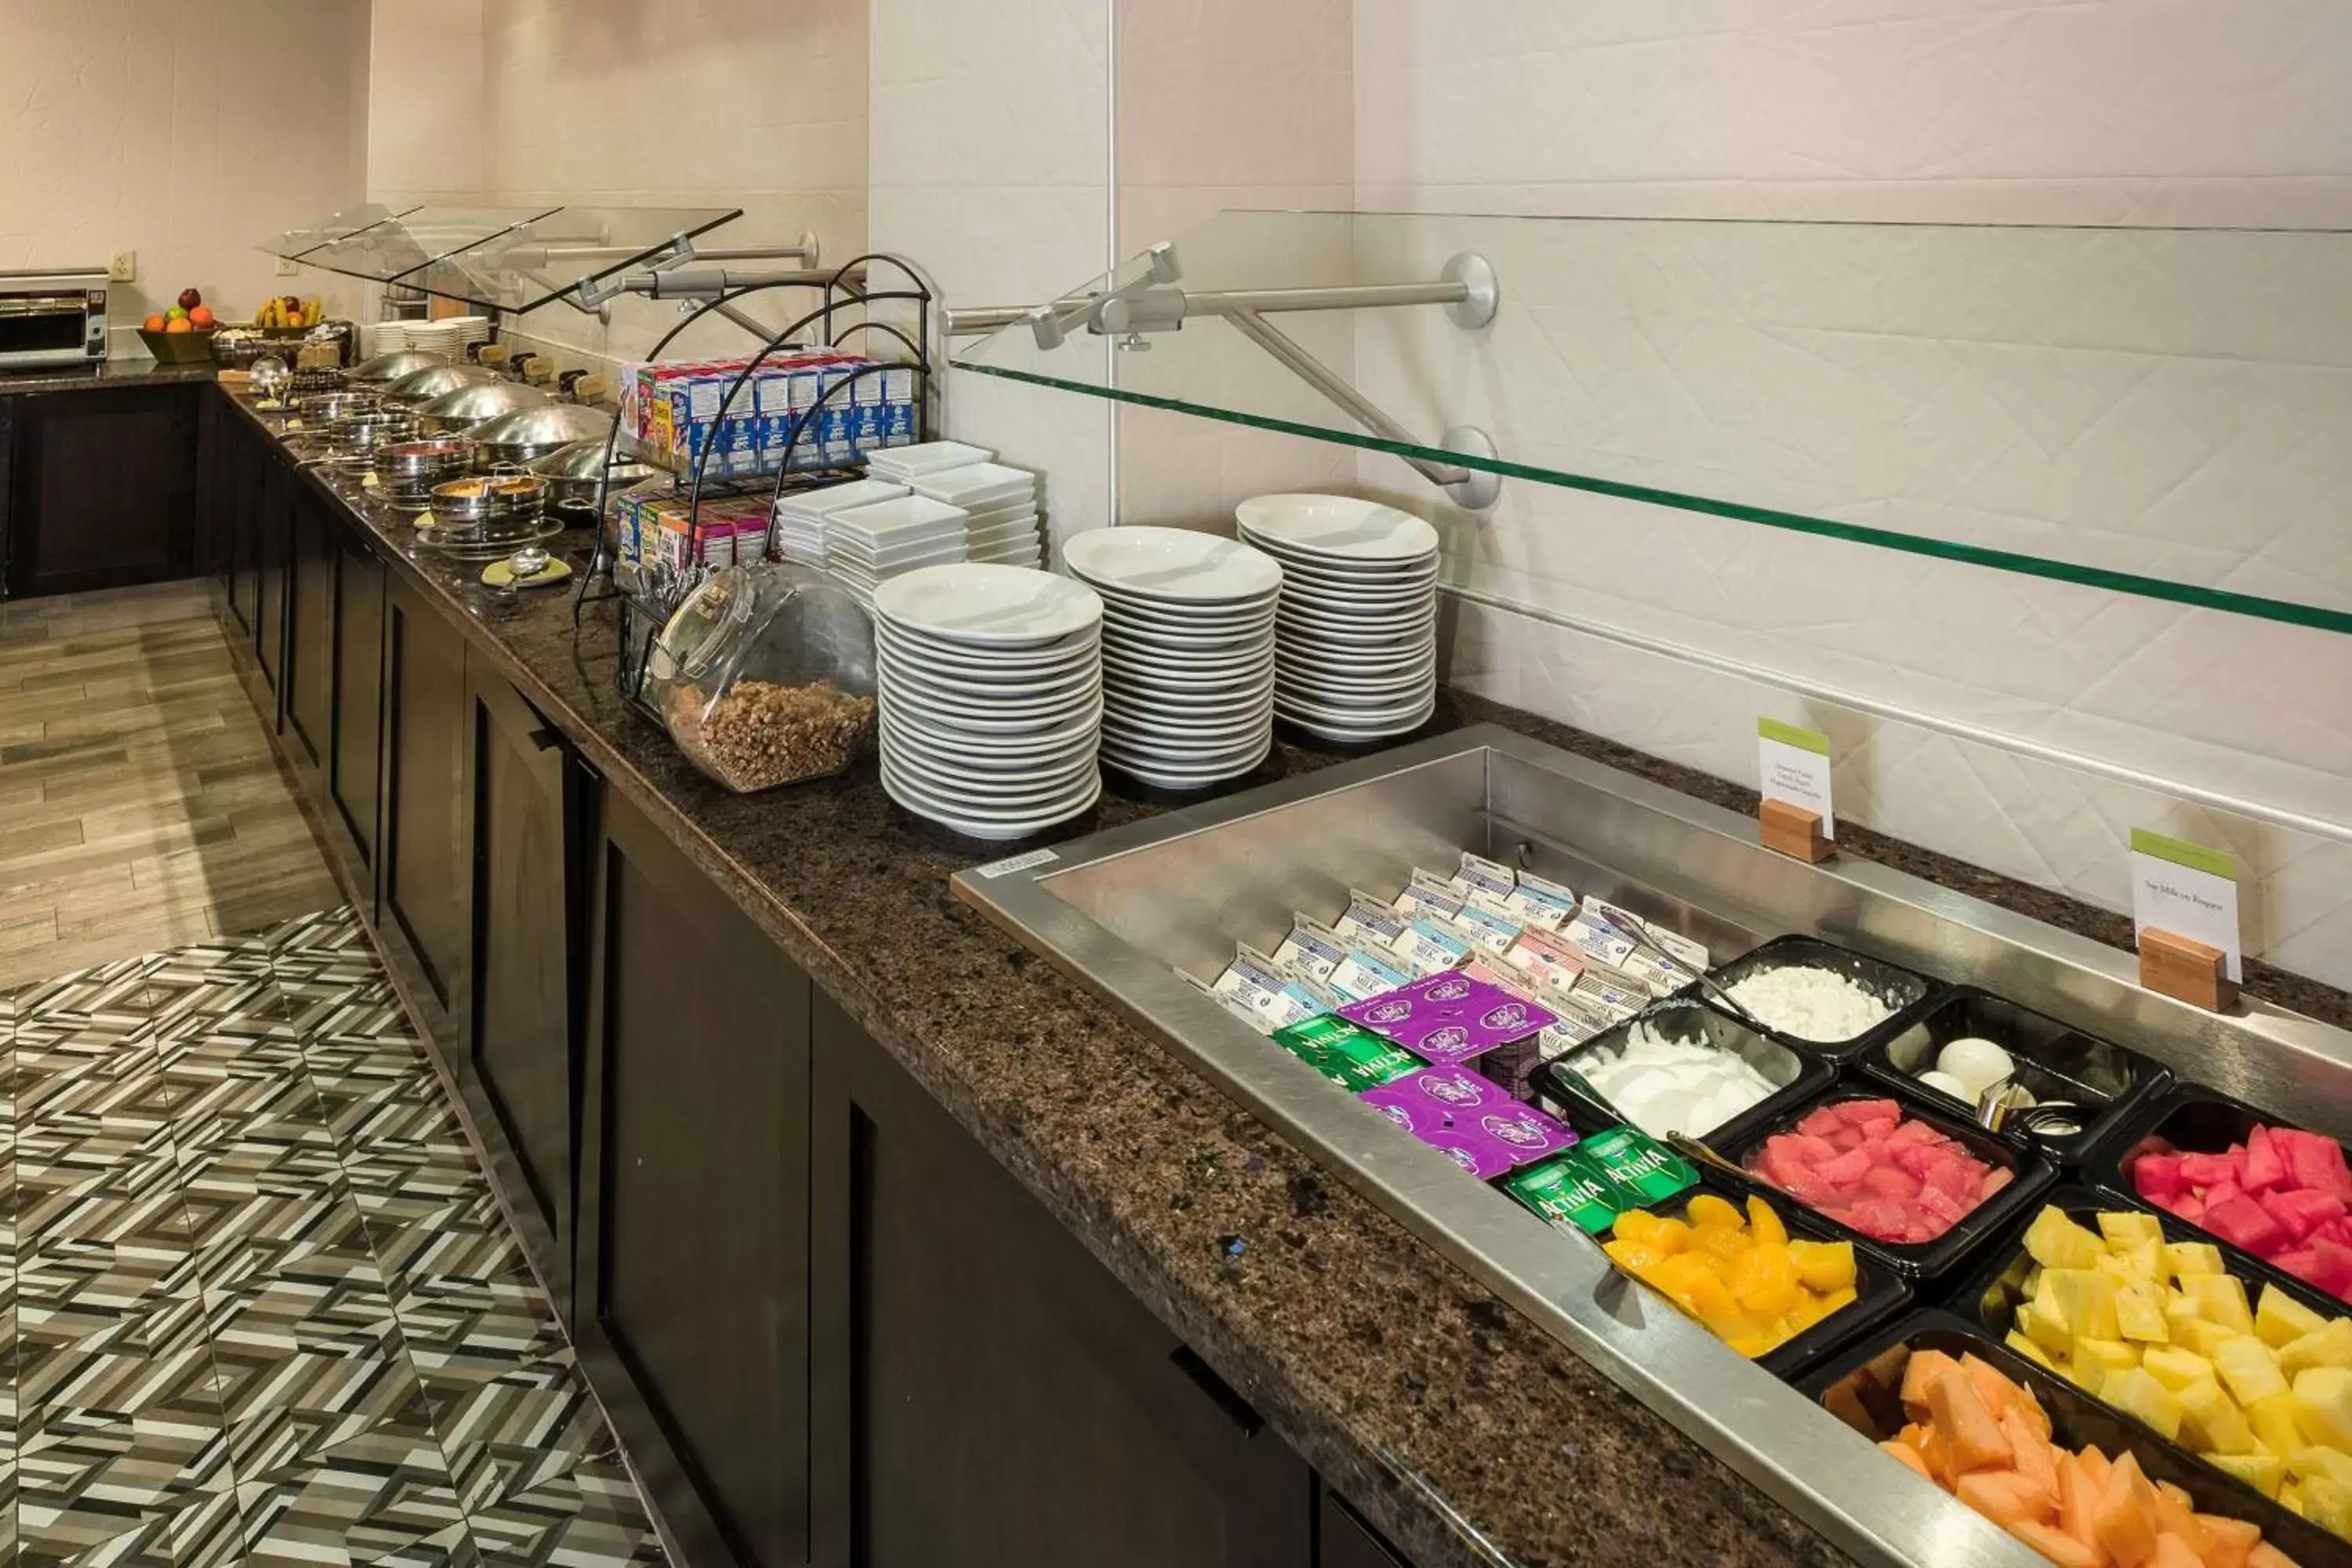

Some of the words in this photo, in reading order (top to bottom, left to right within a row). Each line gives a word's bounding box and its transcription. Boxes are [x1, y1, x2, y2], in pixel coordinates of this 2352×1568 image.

[1301, 1024, 1359, 1048] ACTIVIA
[1541, 1032, 1564, 1051] MILK
[1351, 1048, 1412, 1077] ACTIVIA
[1605, 1148, 1668, 1184] ACTIVIA
[1537, 1178, 1606, 1216] ACTIVIA
